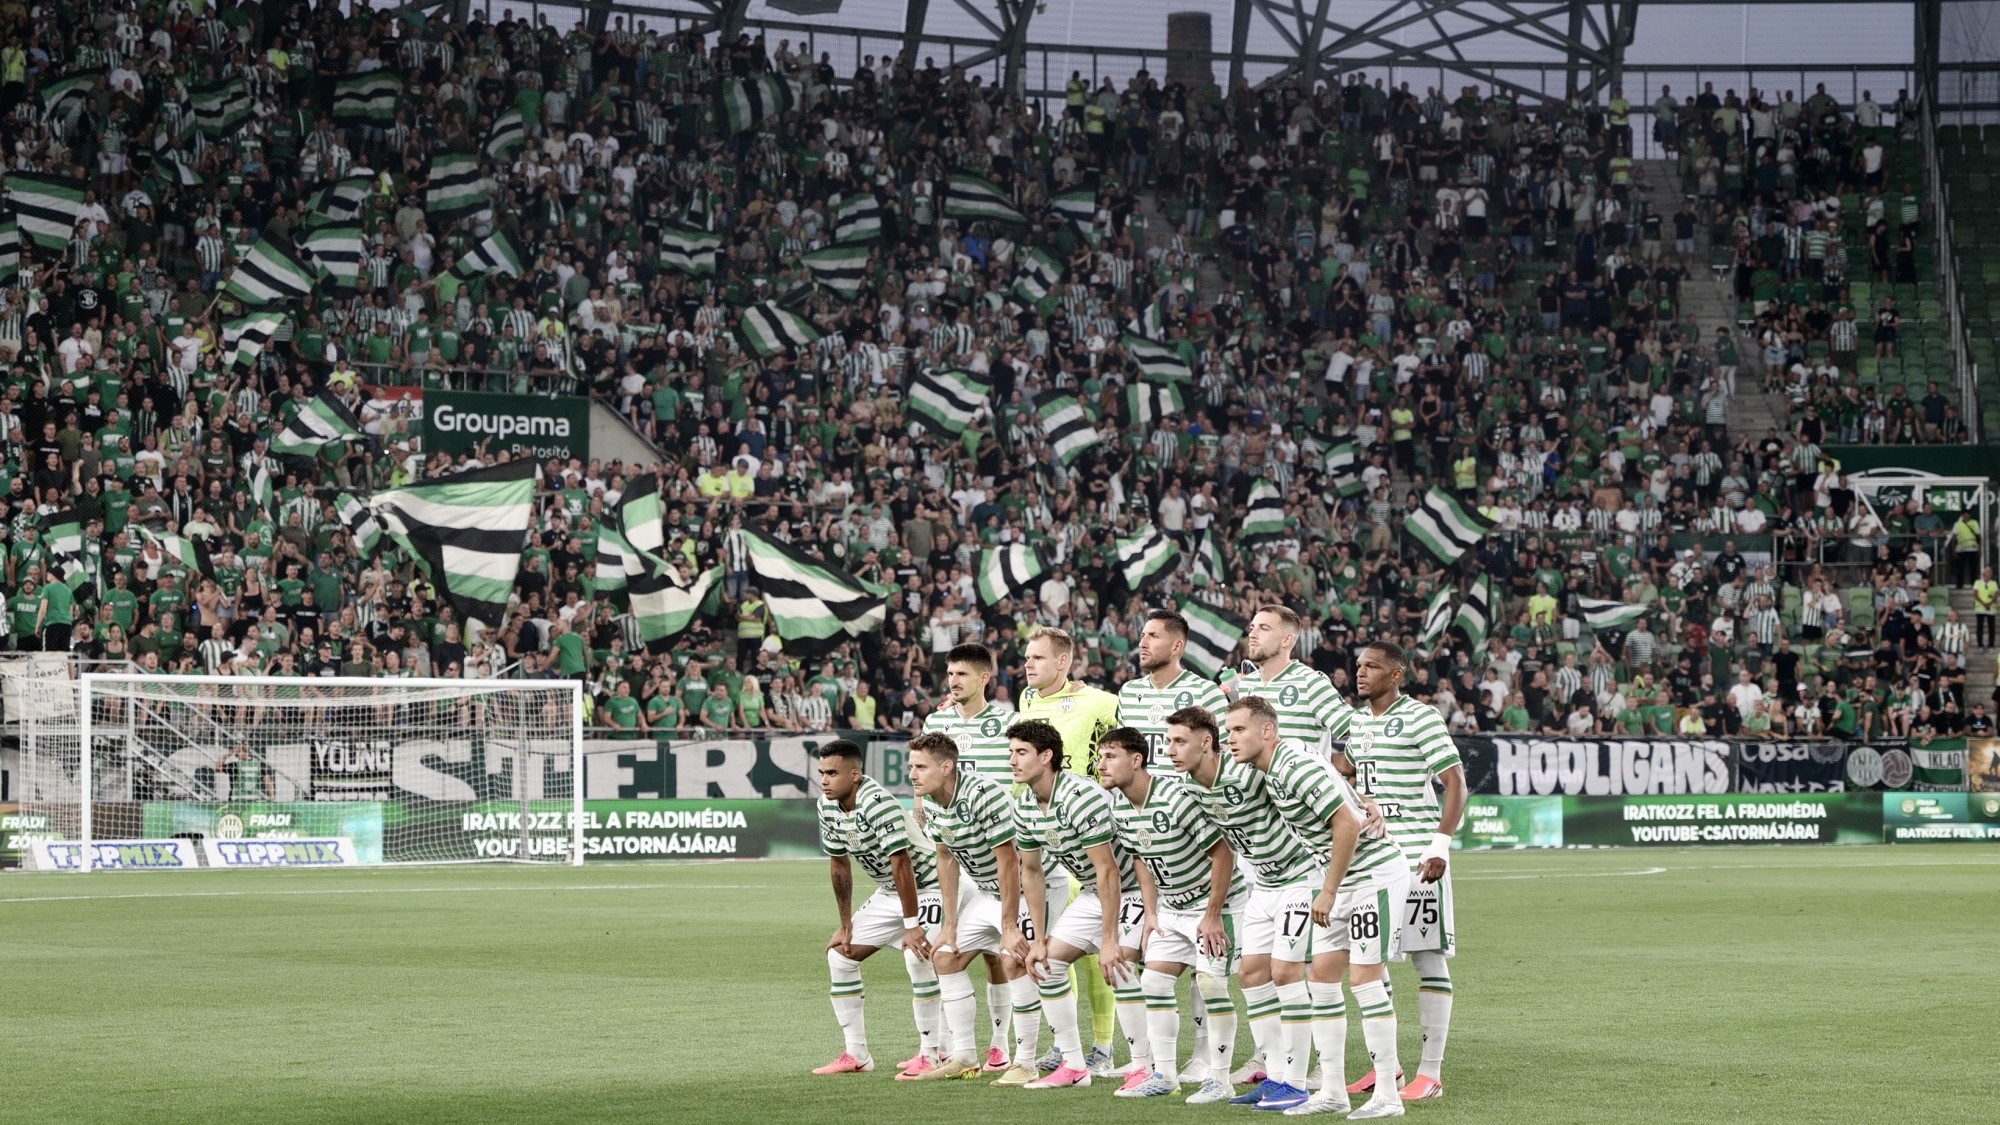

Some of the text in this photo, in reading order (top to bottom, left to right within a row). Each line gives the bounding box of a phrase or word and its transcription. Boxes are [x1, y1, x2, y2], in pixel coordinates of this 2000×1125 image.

[433, 404, 570, 440] Groupama
[512, 443, 570, 460] Btosító
[314, 740, 391, 771] YOUNG
[1492, 738, 1730, 795] HOOLIGANS
[250, 814, 291, 827] FRADI
[463, 812, 563, 831] IRATKOZZ
[606, 811, 622, 829] A
[626, 807, 747, 829] FRADIMÉDIA
[1468, 805, 1498, 817] FRADI
[1623, 800, 1827, 820] IRATKOZZ FEL A FRADIMÉDIA
[2, 816, 46, 829] FRADI
[1472, 818, 1505, 834] ZÓNA
[1631, 821, 1820, 842] YOUTUBE-CSATORNÁJÁRA!
[1896, 827, 1952, 839] IRATKOZZ
[1953, 827, 1974, 838] FEL
[1975, 828, 1986, 838] A
[918, 904, 942, 926] 20
[1119, 903, 1145, 926] 47
[1406, 898, 1438, 925] 75
[1017, 918, 1035, 941] 6
[1282, 910, 1310, 938] 17
[1351, 911, 1379, 940] 88
